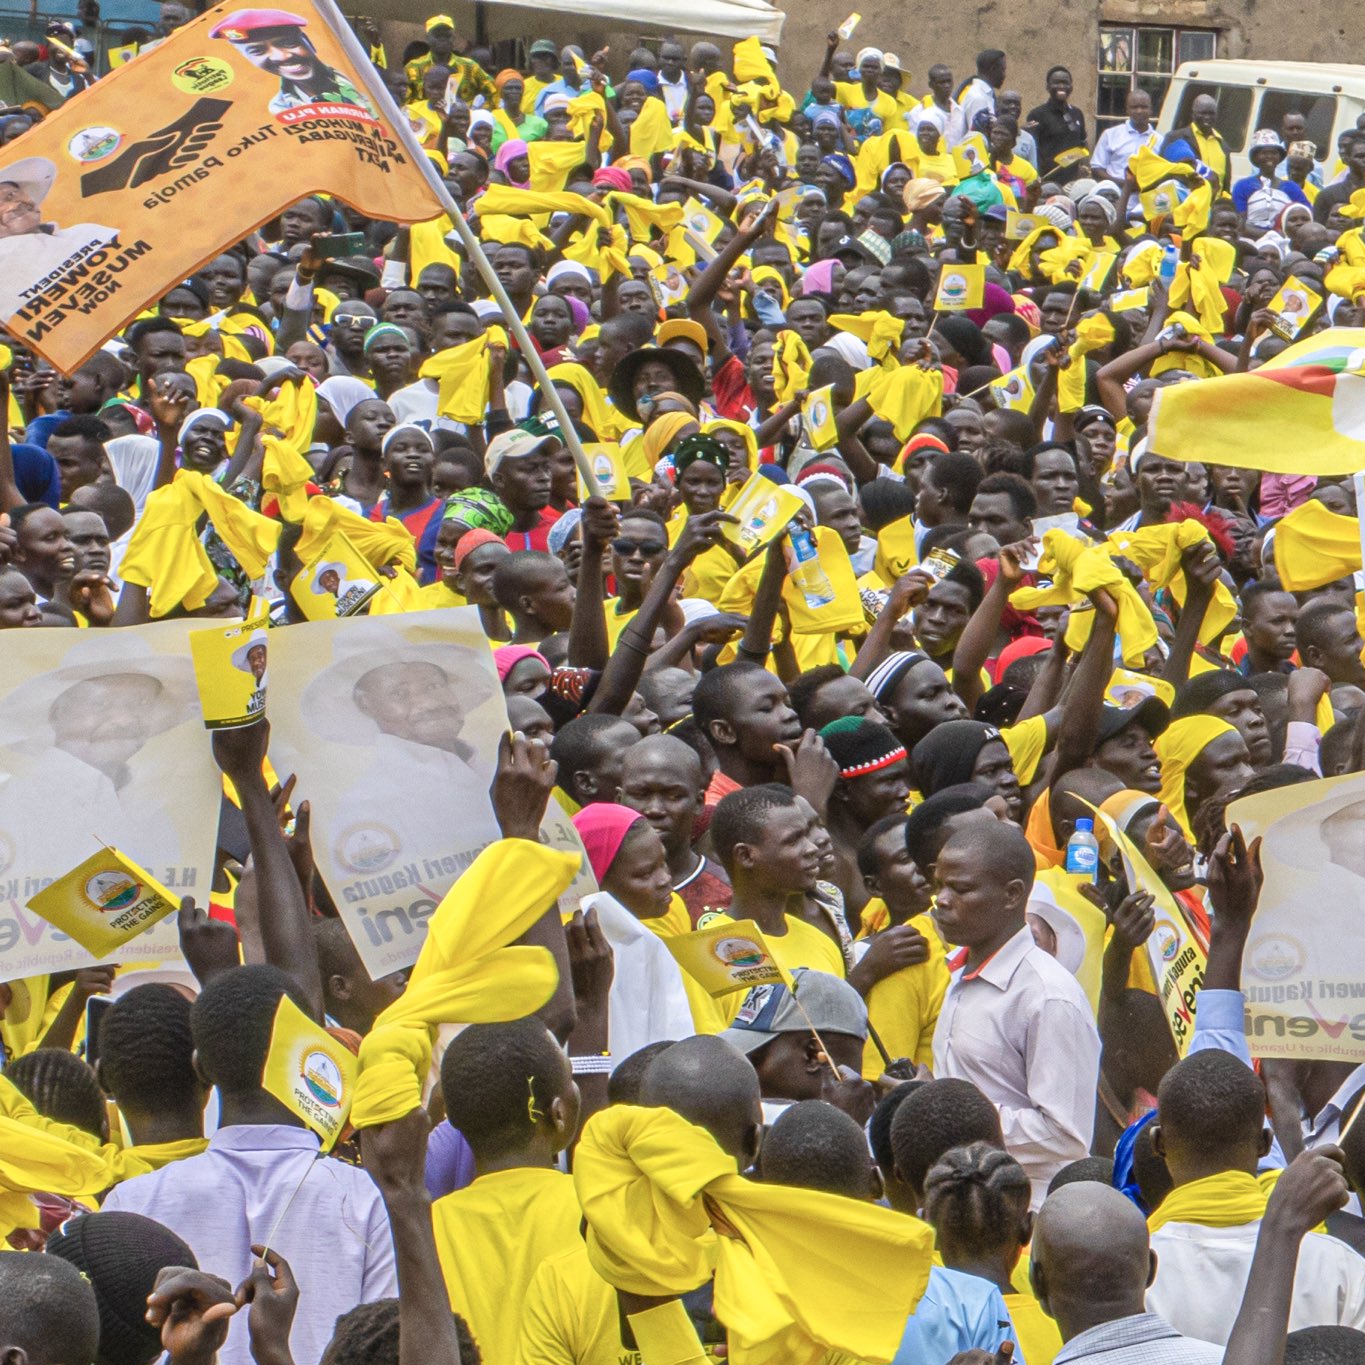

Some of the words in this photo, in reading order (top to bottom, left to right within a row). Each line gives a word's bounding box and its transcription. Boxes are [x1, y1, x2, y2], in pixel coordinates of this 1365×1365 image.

[109, 893, 163, 930] PROTECTING
[121, 918, 140, 931] THE
[139, 901, 165, 923] GAINS
[1169, 946, 1197, 983] Kaguta
[294, 1088, 339, 1130] PROTECTING
[298, 1100, 312, 1116] THE
[313, 1112, 334, 1136] GAINS
